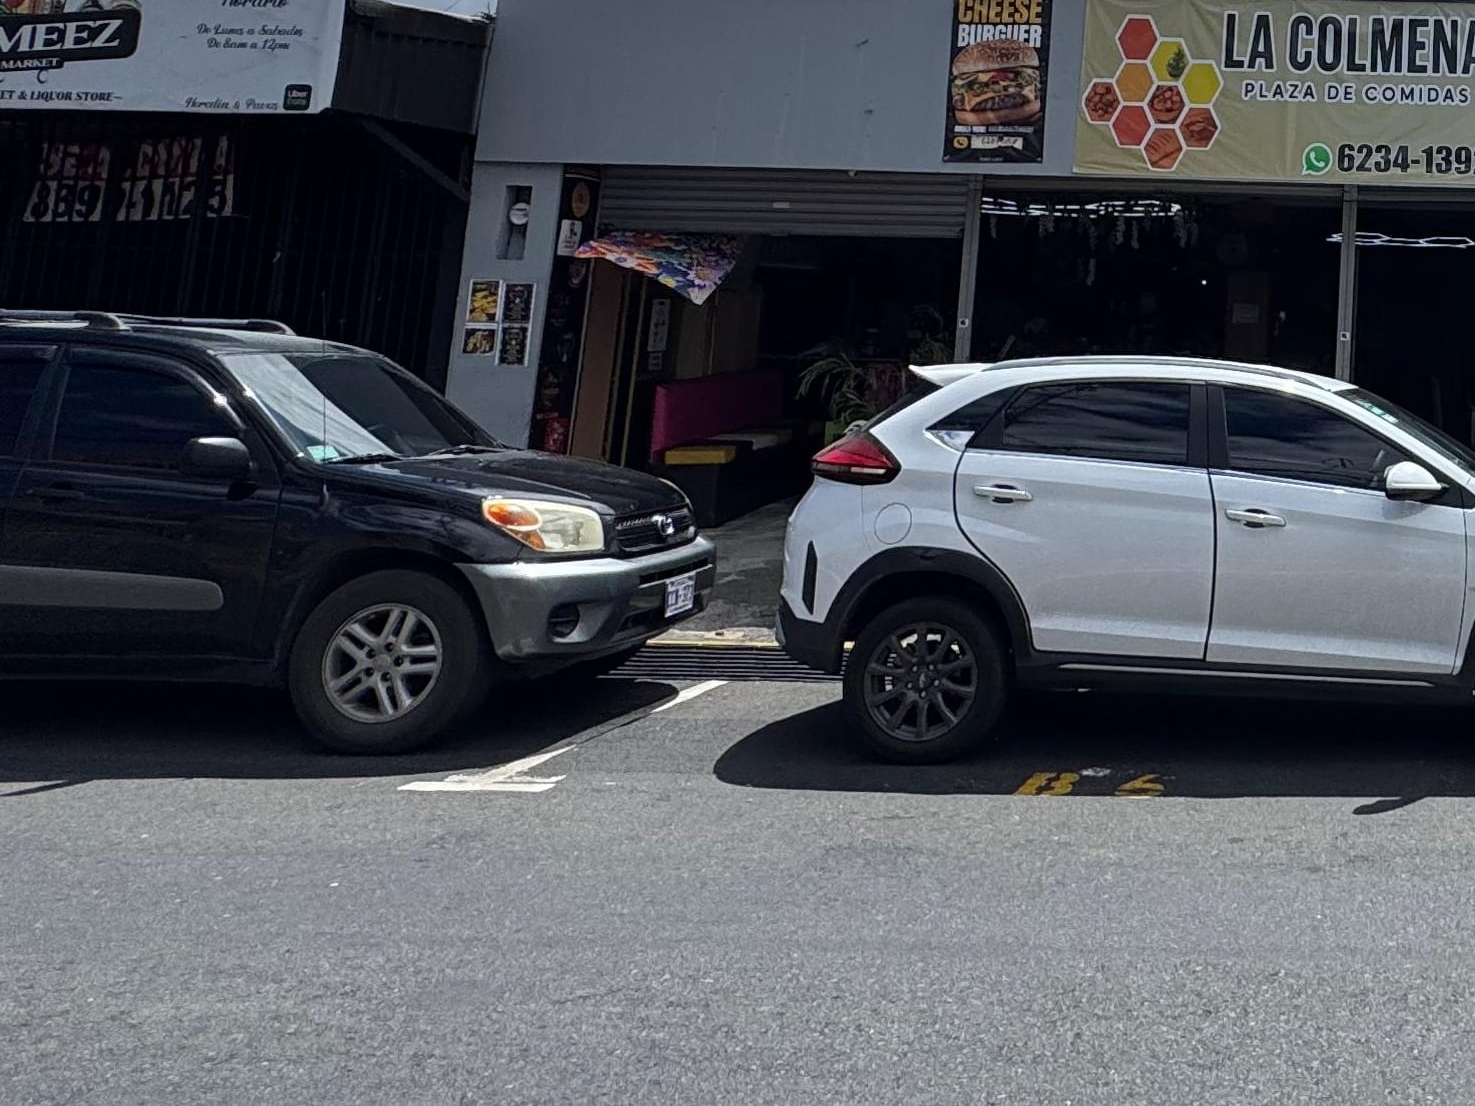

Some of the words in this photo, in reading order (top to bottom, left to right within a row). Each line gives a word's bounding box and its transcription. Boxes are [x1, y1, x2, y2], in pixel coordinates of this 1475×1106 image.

[261, 38, 291, 52] 12pm
[957, 24, 1043, 48] BURGUER
[1222, 11, 1276, 71] LA
[0, 57, 61, 69] MARKET
[18, 91, 28, 100] &
[30, 91, 73, 103] LIQUOR
[1243, 82, 1315, 102] PLAZA
[1327, 84, 1354, 102] DE
[1364, 85, 1471, 105] COMIDAS
